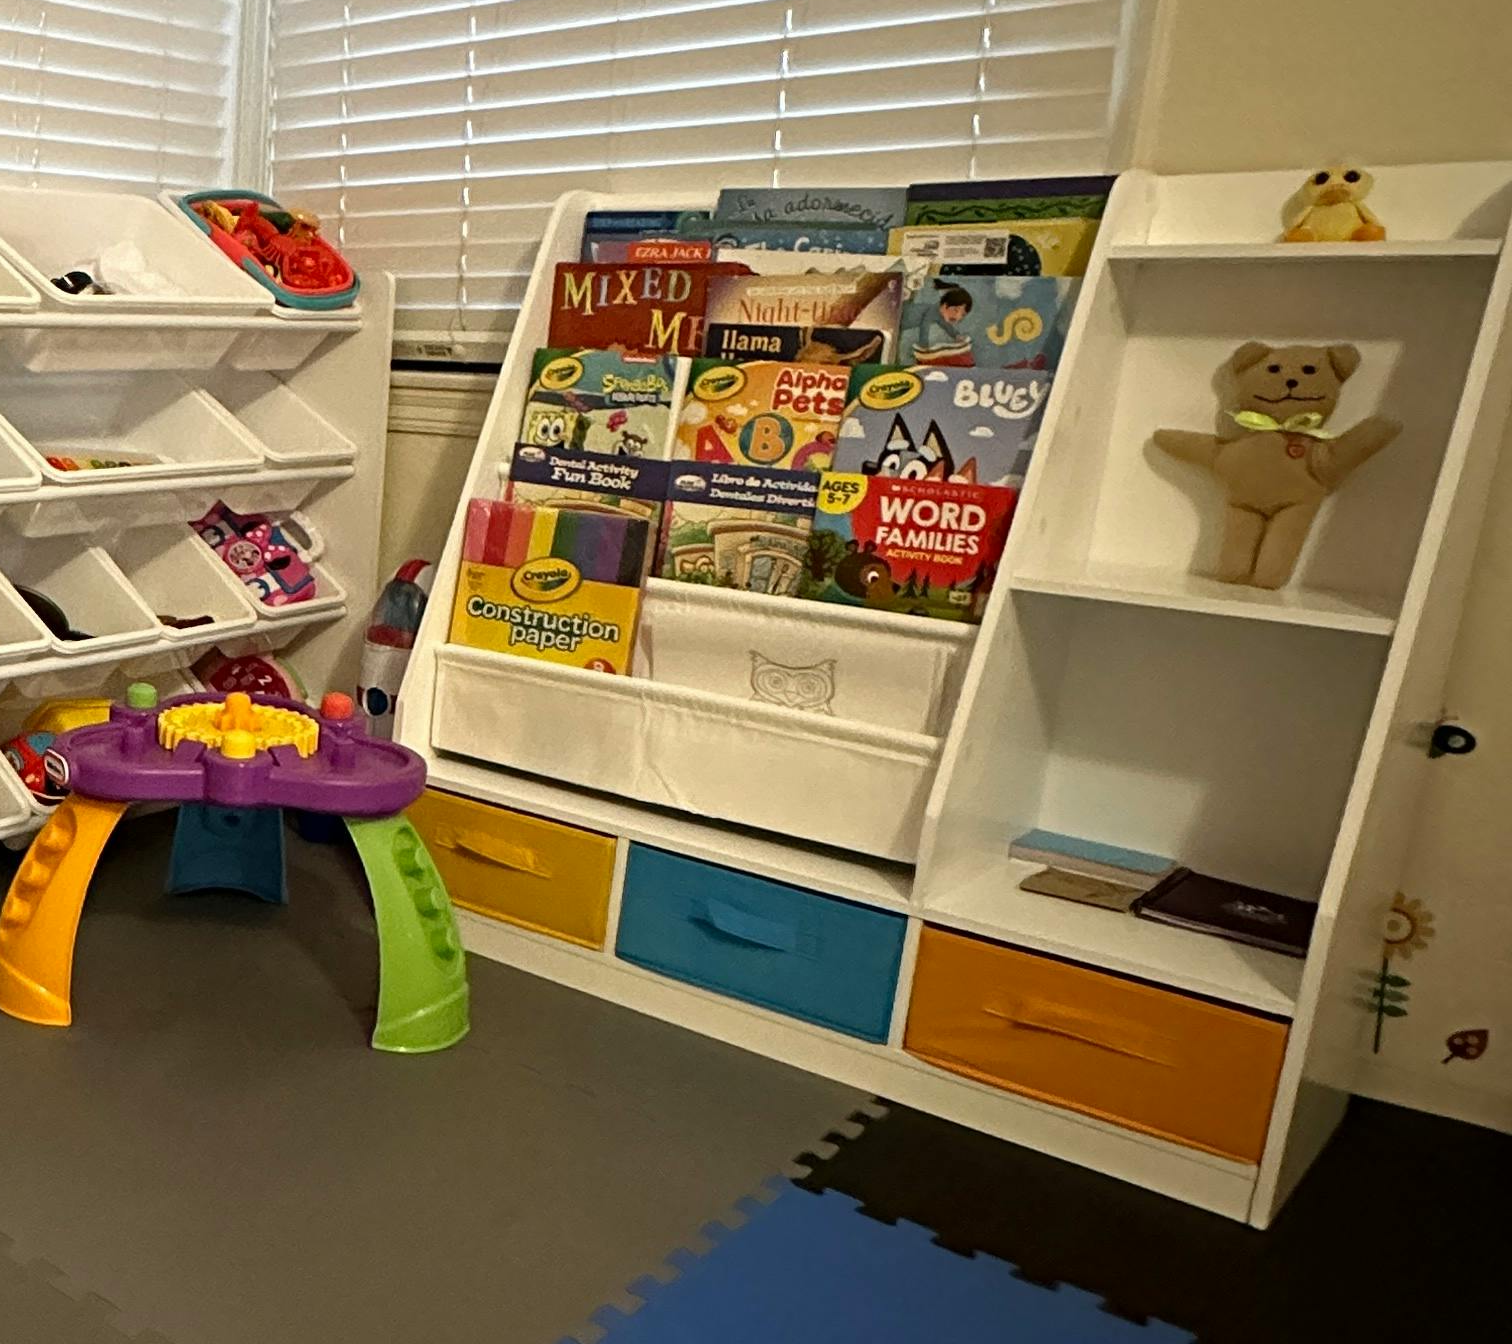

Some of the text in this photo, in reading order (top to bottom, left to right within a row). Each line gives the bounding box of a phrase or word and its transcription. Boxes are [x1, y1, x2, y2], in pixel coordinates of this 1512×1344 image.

[635, 246, 668, 259] EZRA
[671, 247, 702, 259] JACK
[560, 267, 692, 316] MIXED
[739, 297, 858, 324] Night-ti
[722, 329, 781, 353] llama
[776, 369, 848, 394] Alpha
[772, 388, 845, 416] Pets
[953, 378, 1051, 419] BLUEY
[748, 416, 786, 463] B
[549, 456, 640, 479] Dental Activity
[550, 467, 632, 490] Fun Book
[711, 474, 745, 486] Libro
[745, 476, 761, 488] de
[822, 481, 860, 494] AGES
[902, 485, 981, 500] SCHOLASTIC
[826, 493, 851, 505] 5-7
[879, 496, 986, 532] WORD
[875, 526, 980, 555] FAMILIES
[886, 549, 964, 565] ACTIVITY BOOK
[522, 568, 572, 582] Crayola
[467, 596, 619, 641] Construction
[510, 625, 582, 651] paper
